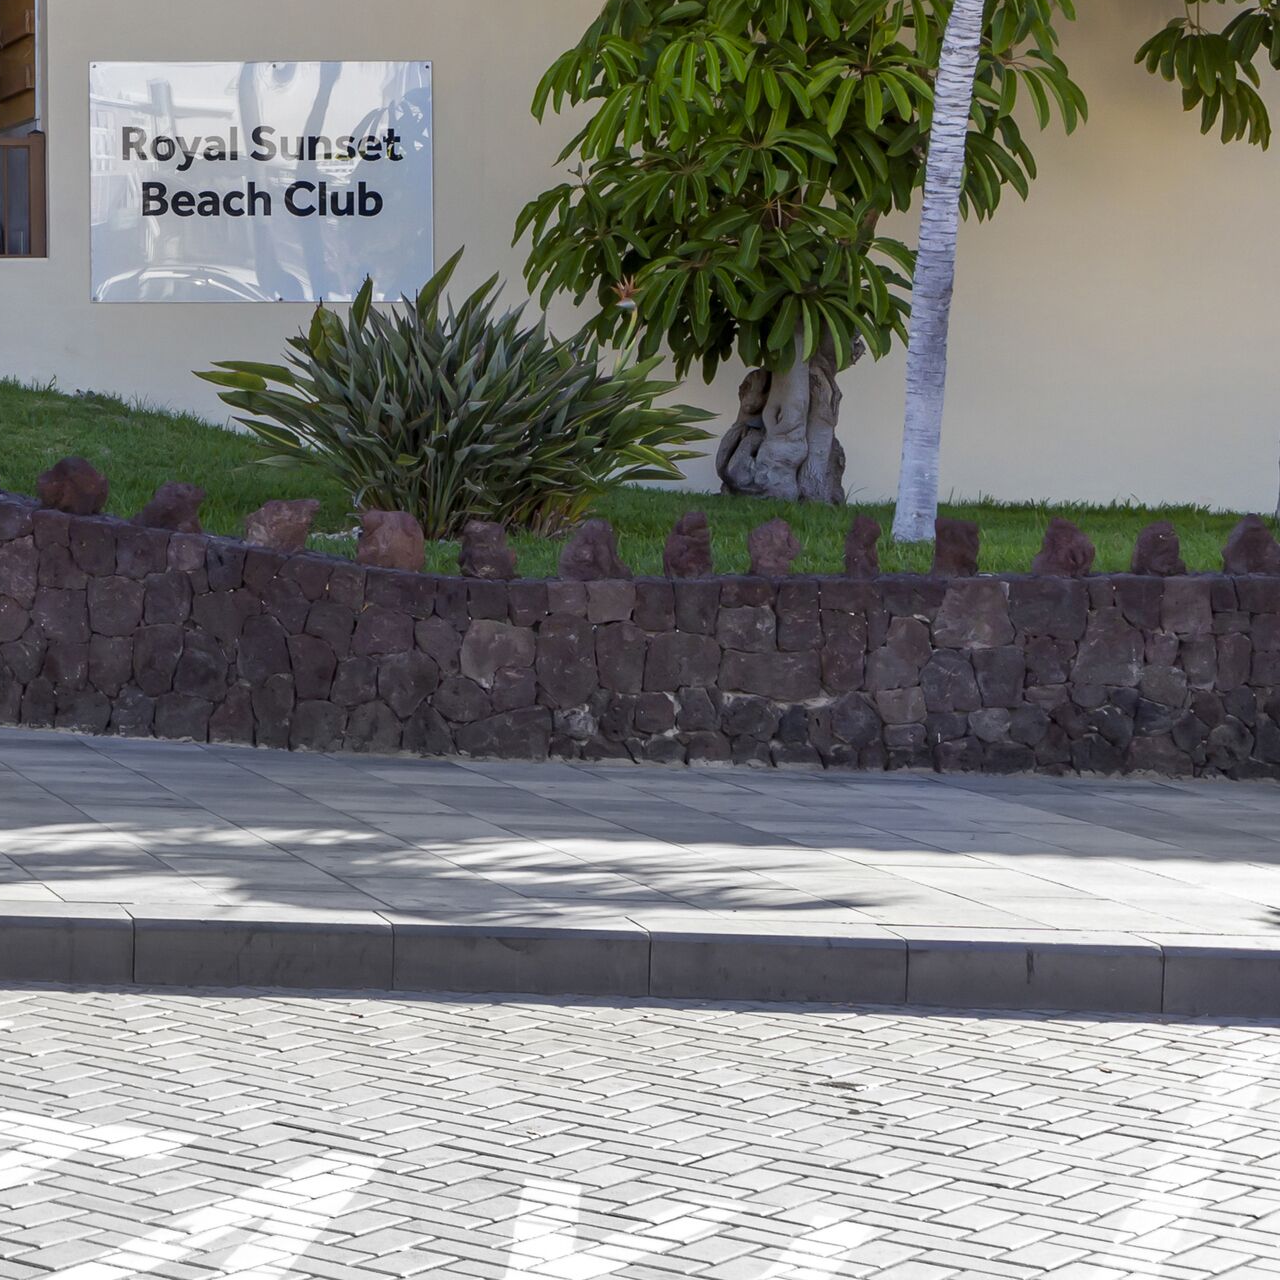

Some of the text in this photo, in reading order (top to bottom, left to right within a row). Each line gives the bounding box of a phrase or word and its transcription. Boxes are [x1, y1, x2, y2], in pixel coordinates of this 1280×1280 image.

[121, 125, 405, 172] Royal Sunset
[141, 180, 384, 217] Beach Club
